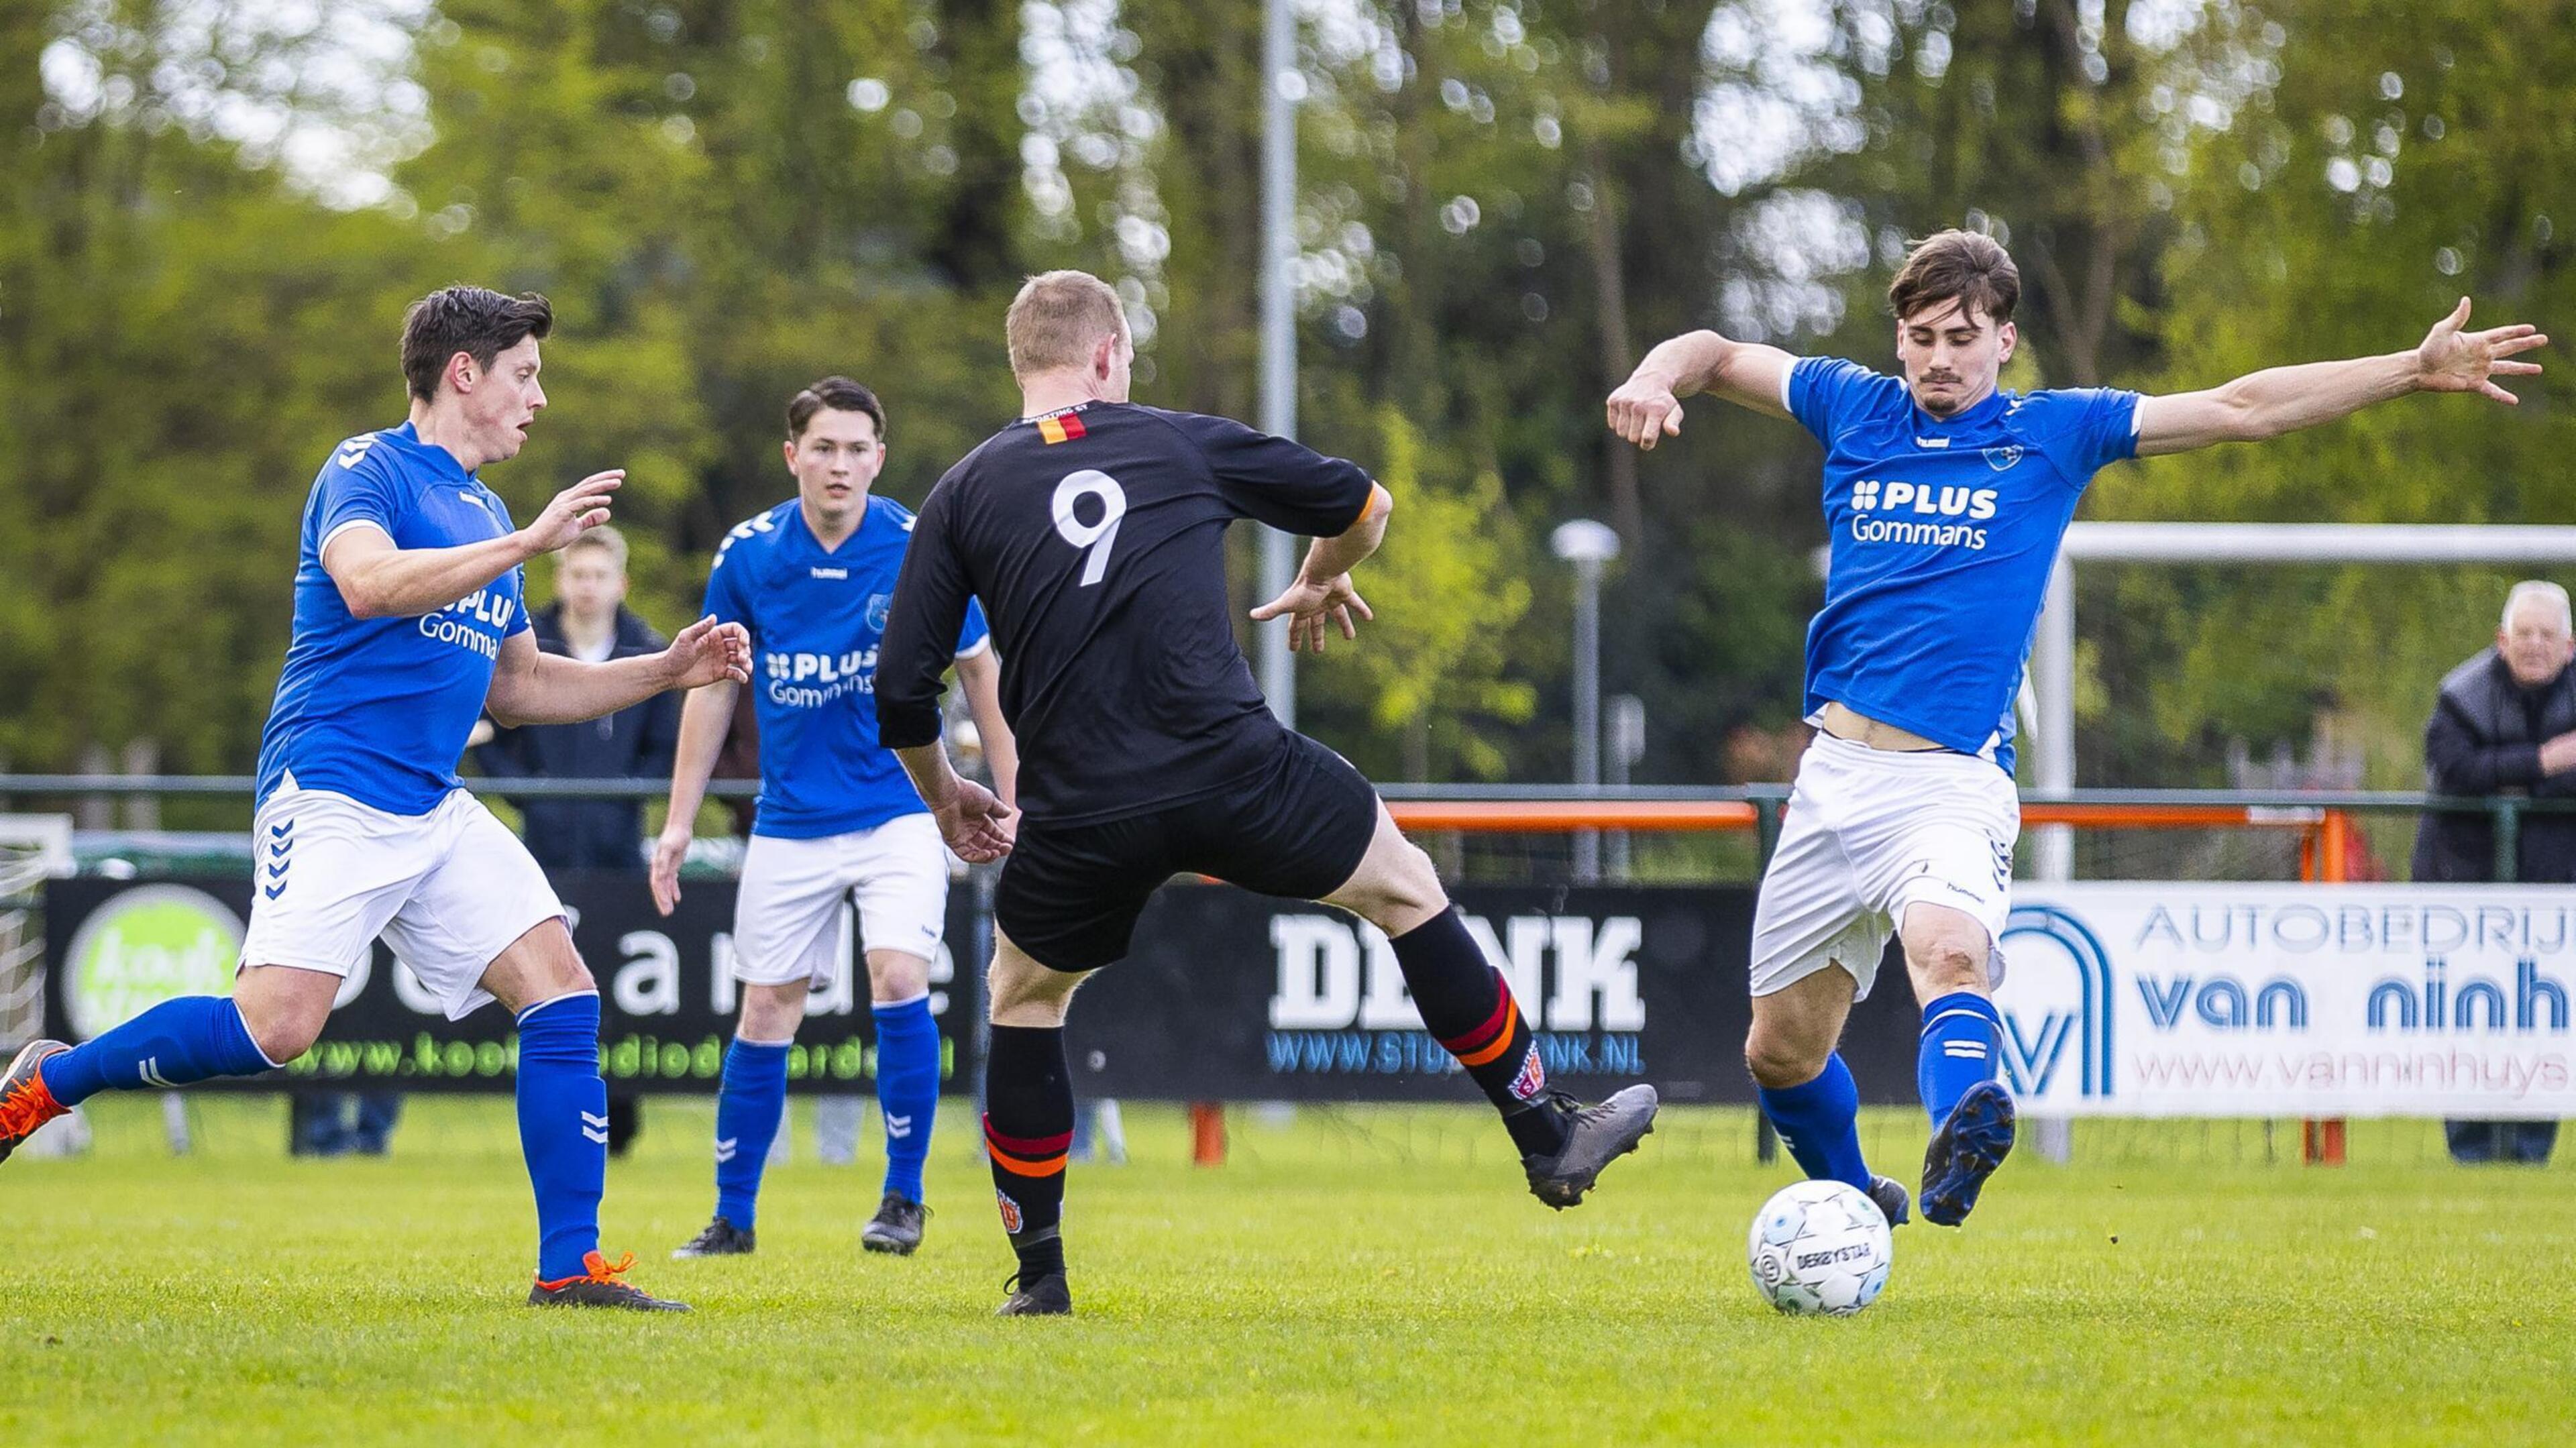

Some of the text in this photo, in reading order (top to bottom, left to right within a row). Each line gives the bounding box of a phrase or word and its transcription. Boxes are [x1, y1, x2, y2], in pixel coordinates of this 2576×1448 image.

[1882, 482, 1998, 520] PLUS
[1052, 469, 1127, 587] 9
[1851, 514, 1988, 550] Gommans
[457, 590, 515, 628] PLU
[419, 612, 501, 661] Gomma
[2135, 903, 2576, 953] AUTOBEDRIJ
[2135, 954, 2572, 1032] van ninh
